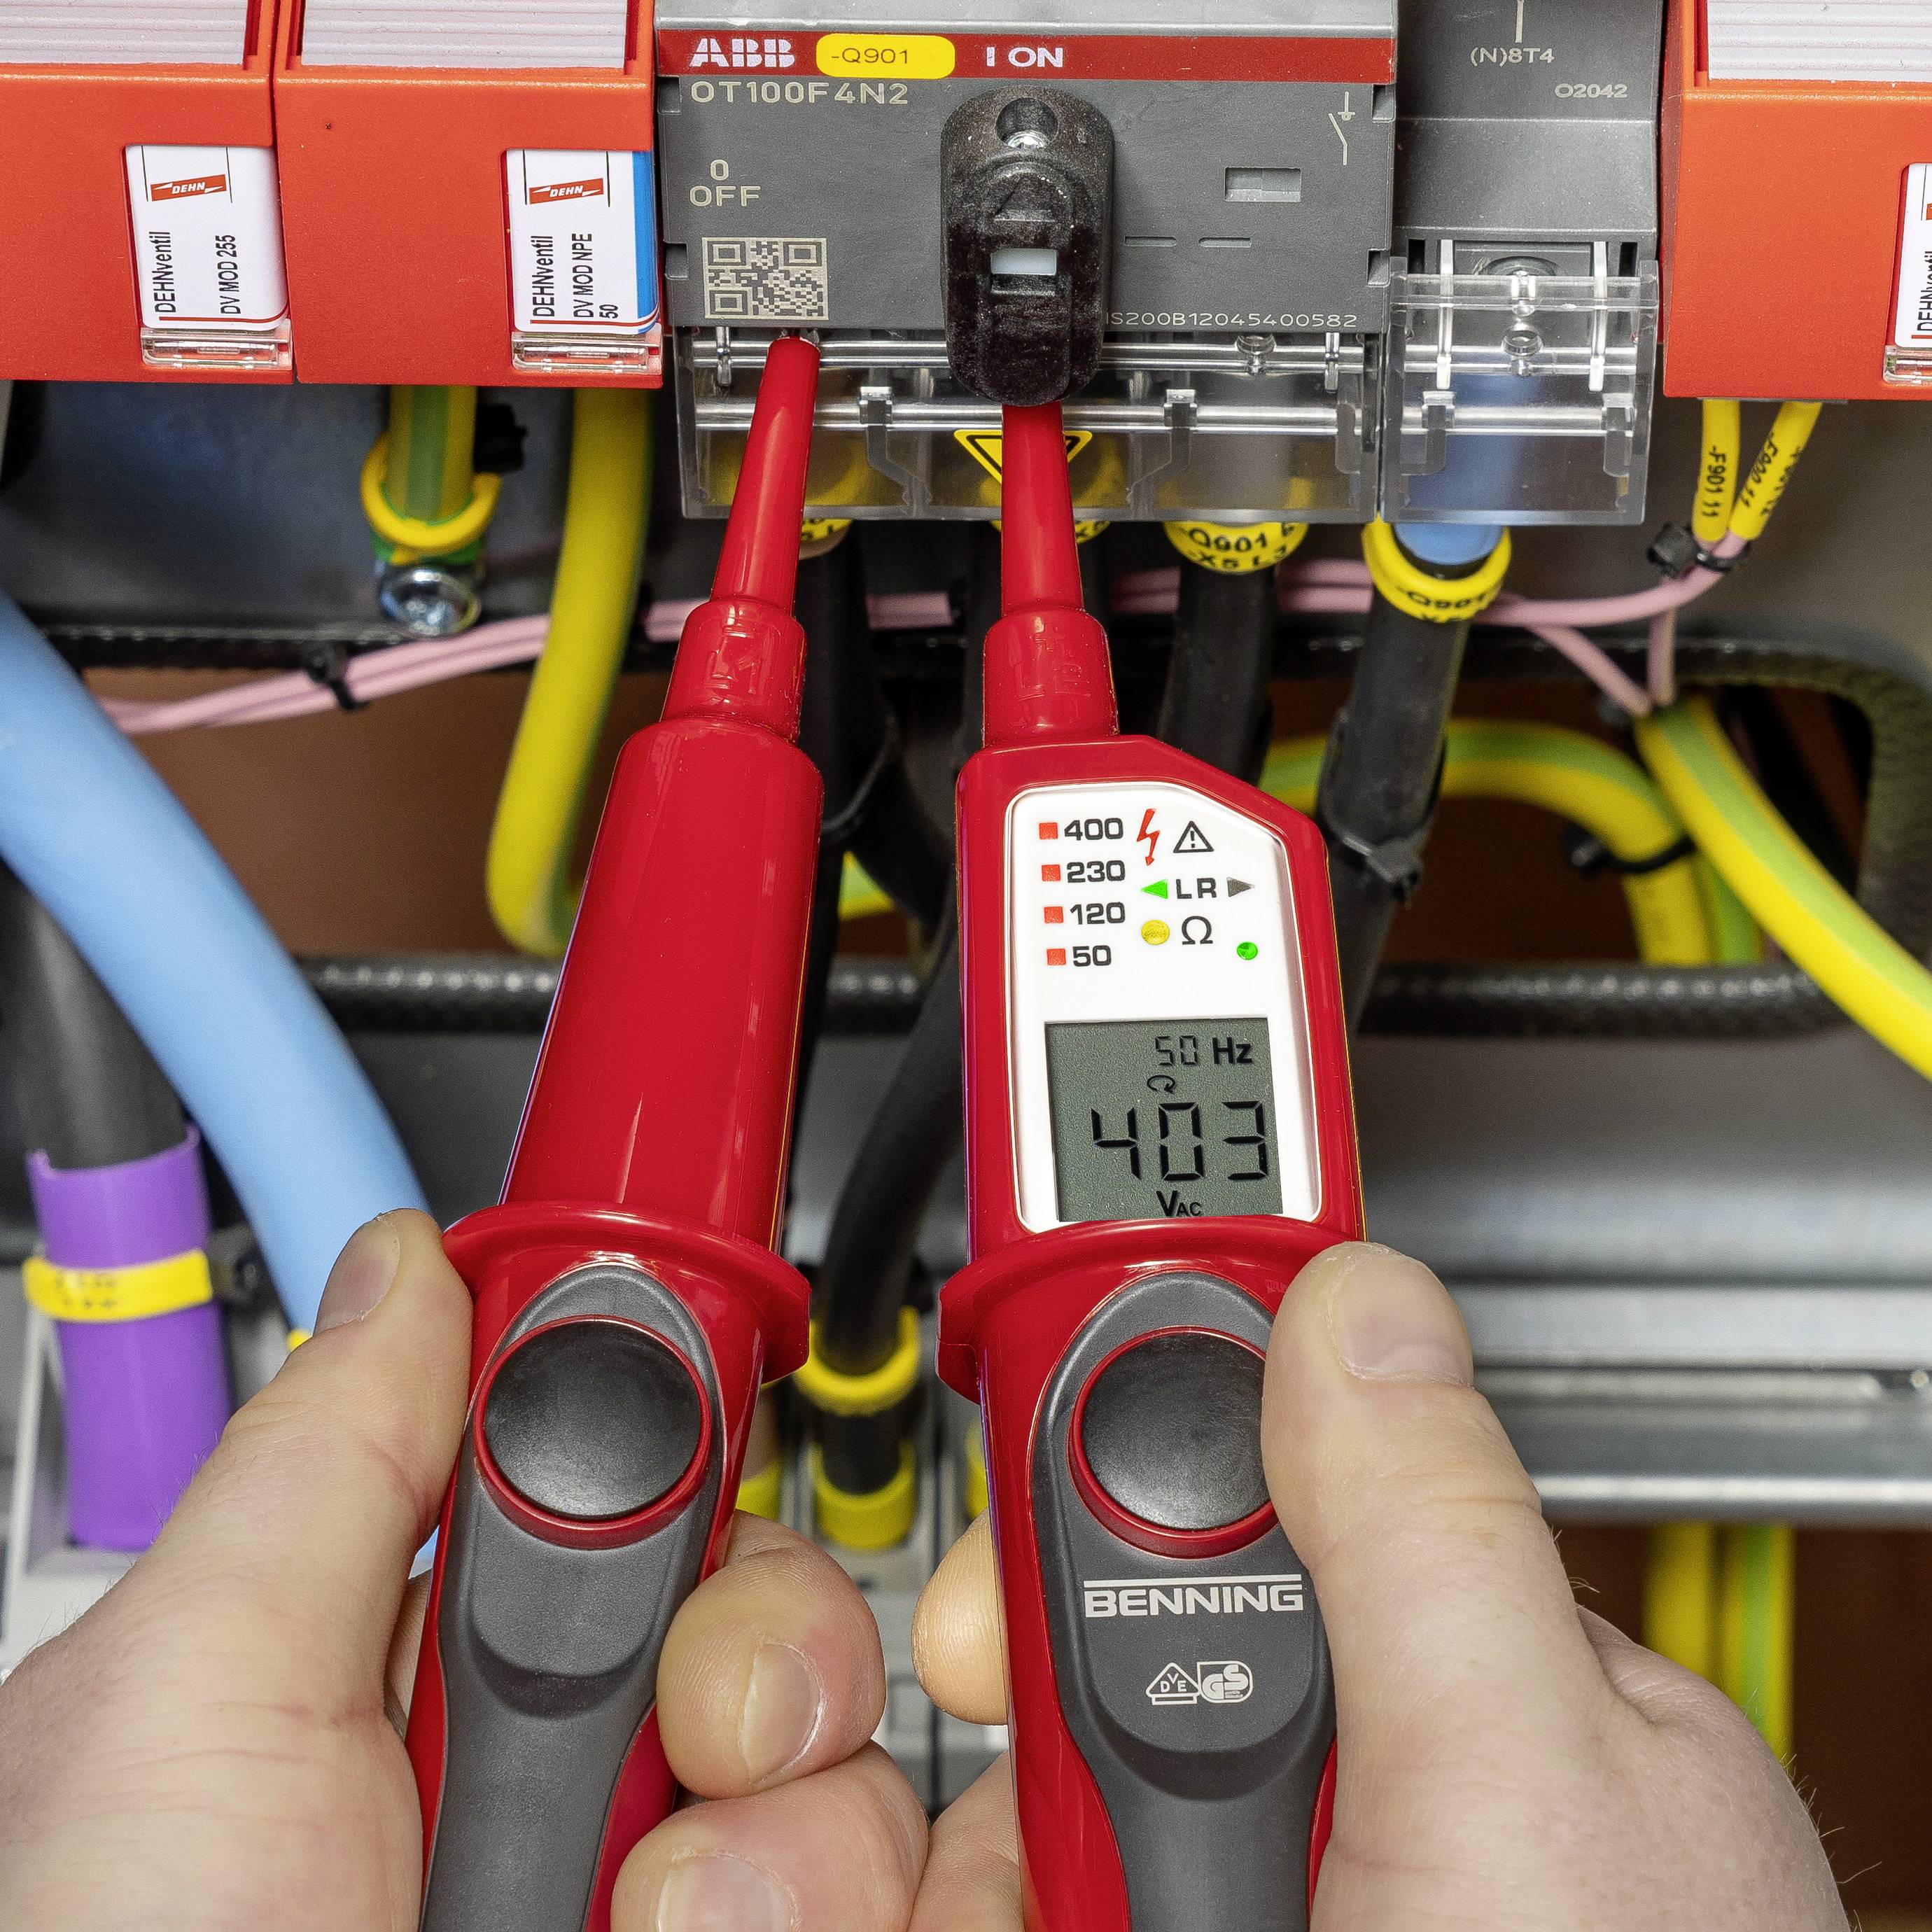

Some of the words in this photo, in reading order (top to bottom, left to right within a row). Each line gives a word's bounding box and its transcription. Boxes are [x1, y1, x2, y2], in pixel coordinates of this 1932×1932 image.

[690, 38, 796, 68] ABB
[831, 48, 909, 64] -Q901
[1008, 48, 1063, 68] ON
[1471, 46, 1555, 68] (N)8T4
[690, 80, 909, 106] OT100F4N2
[172, 181, 206, 195] DEHN
[550, 185, 584, 198] DEHN
[689, 186, 761, 206] OFF
[215, 234, 237, 258] 255
[571, 233, 593, 260] NPE
[148, 231, 176, 313] DEHNventil
[217, 261, 240, 293] MOD
[531, 235, 555, 317] DEHNventil
[573, 265, 594, 296] MOD
[220, 295, 241, 314] DV
[573, 300, 594, 318] DV
[598, 304, 619, 319] 50
[1063, 818, 1124, 841] 400
[1066, 860, 1126, 883] 230
[1070, 902, 1126, 925] 120
[1072, 945, 1112, 967] 50
[1155, 1035, 1198, 1066] 50
[1212, 1036, 1253, 1065] Hz
[1091, 1100, 1268, 1182] 403
[1084, 1583, 1303, 1618] BENNING
